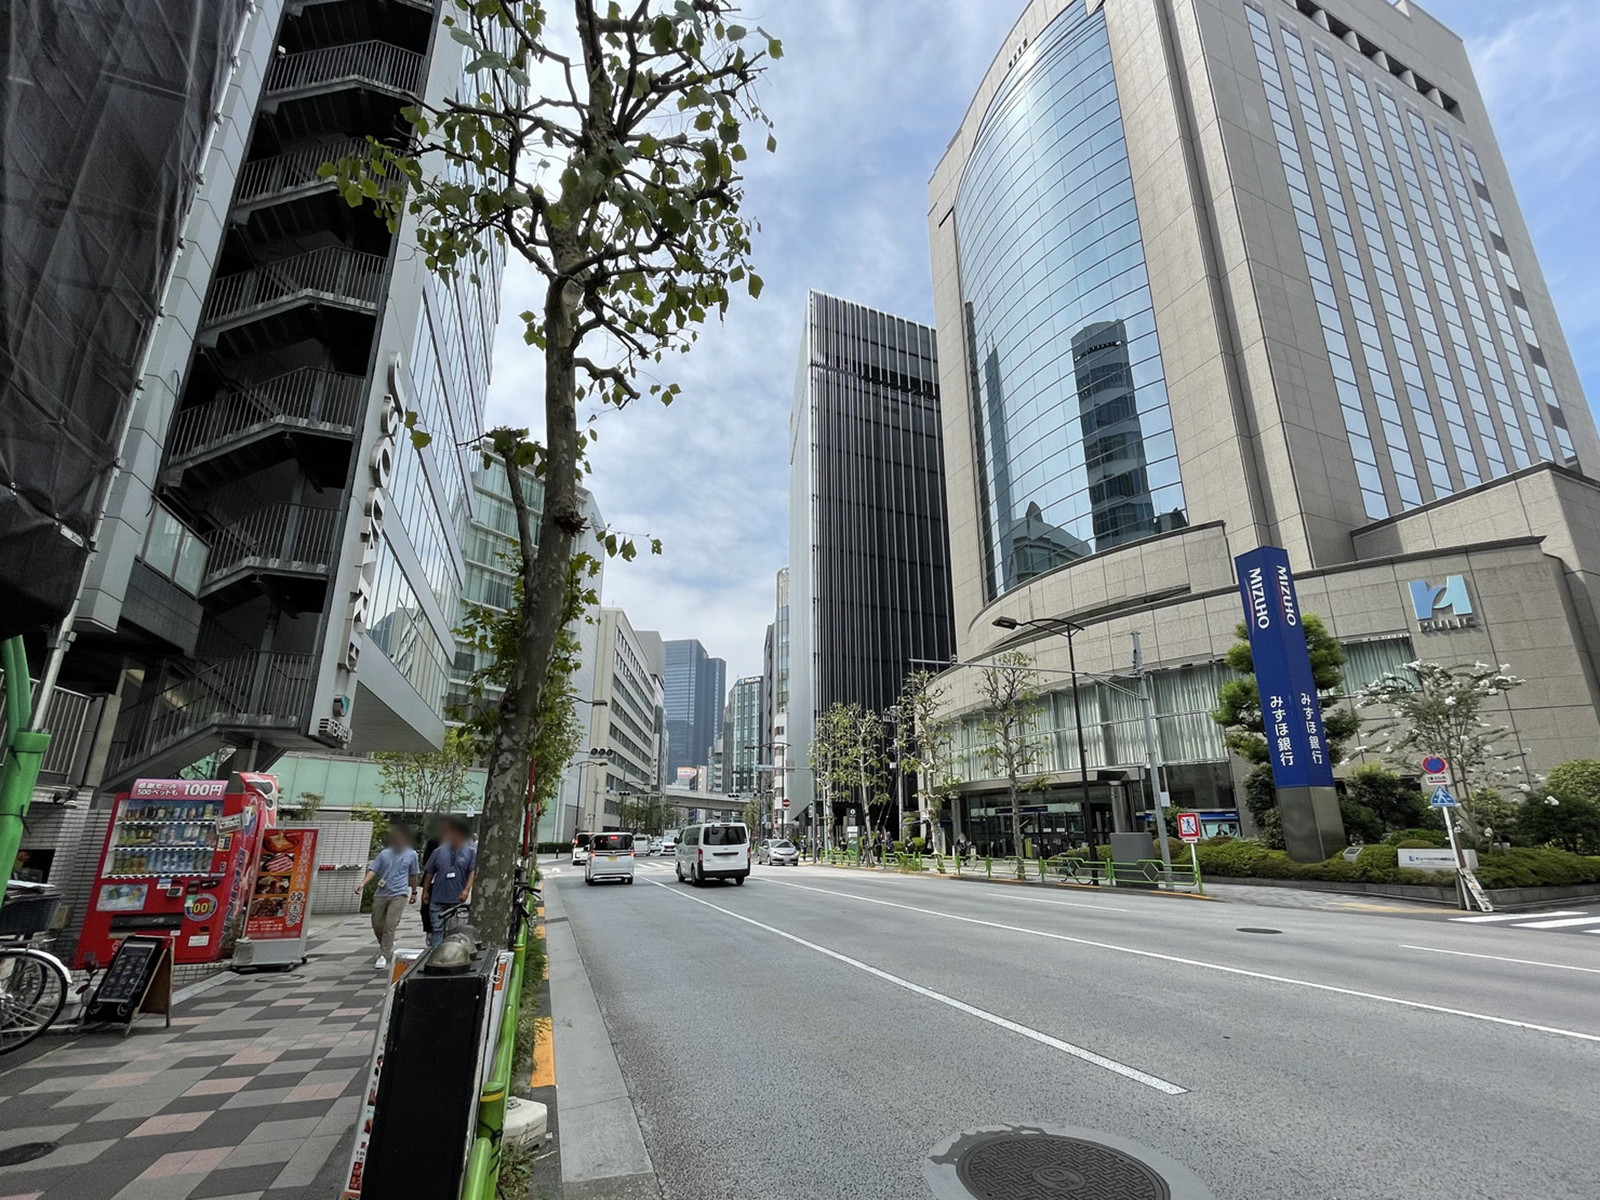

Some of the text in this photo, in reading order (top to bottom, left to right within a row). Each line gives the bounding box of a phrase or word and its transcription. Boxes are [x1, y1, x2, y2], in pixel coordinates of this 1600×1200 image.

[1249, 566, 1270, 630] MIZUHO
[1276, 565, 1297, 628] MIZUHO
[1417, 616, 1477, 633] HULIC
[1269, 695, 1294, 767] みずほ銀行
[1300, 692, 1323, 765] みずほ銀行
[184, 783, 224, 797] 100円
